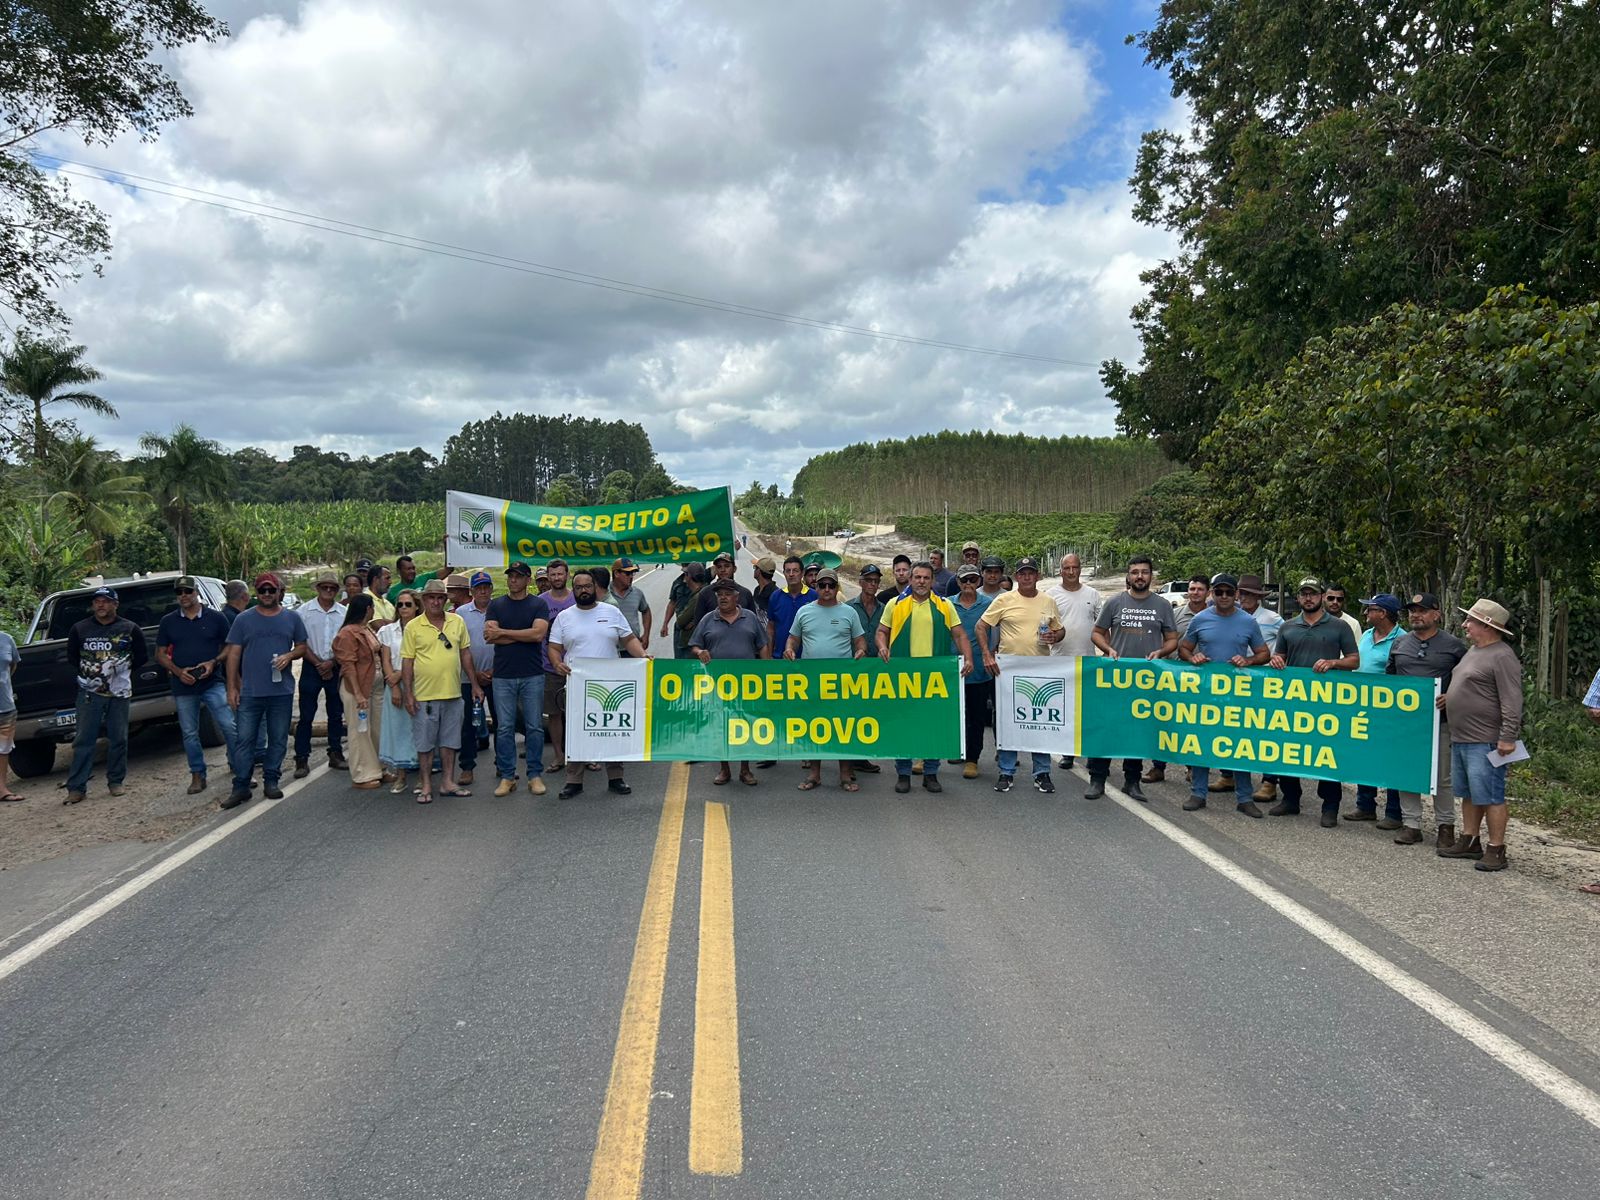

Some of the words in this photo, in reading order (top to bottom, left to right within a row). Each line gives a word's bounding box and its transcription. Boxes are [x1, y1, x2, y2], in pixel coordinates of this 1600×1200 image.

[539, 507, 670, 532] RESPEITO
[677, 503, 695, 524] A
[460, 531, 492, 544] SPR
[517, 528, 721, 560] CONSTITUIÇÃO
[83, 641, 112, 651] AGRO
[659, 673, 682, 701] O
[693, 673, 809, 701] PODER
[819, 671, 949, 700] EMANA
[1096, 668, 1200, 693] LUGAR
[1211, 674, 1252, 697] DE
[1262, 677, 1420, 711] BANDIDO
[586, 712, 632, 728] SPR
[1016, 707, 1061, 722] SPR
[1131, 699, 1339, 736] CONDENADO
[1350, 712, 1369, 740] É
[728, 718, 775, 745] DO
[786, 716, 880, 745] POVO
[1158, 732, 1202, 755] NA
[1212, 736, 1337, 769] CADEIA
